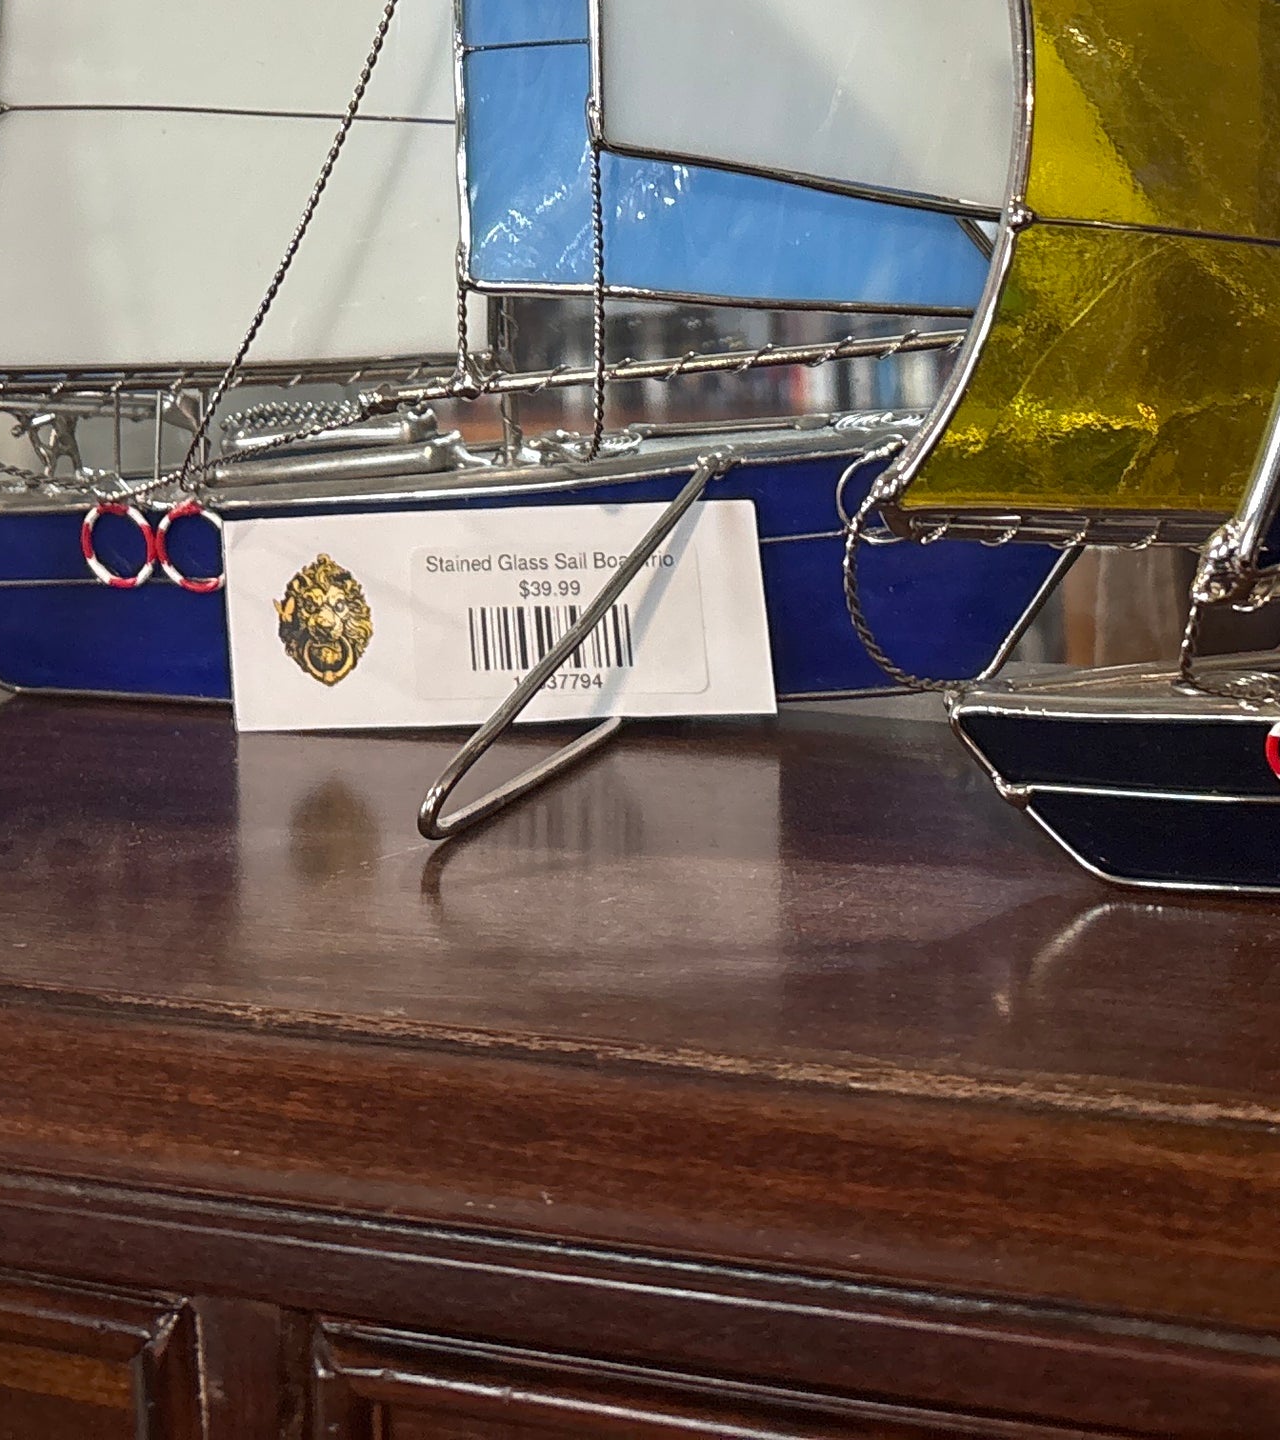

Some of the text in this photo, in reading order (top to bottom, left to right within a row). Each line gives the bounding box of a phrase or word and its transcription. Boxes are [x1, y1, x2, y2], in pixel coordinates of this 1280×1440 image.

[425, 554, 492, 573] Stained
[498, 553, 549, 571] Glass
[554, 552, 588, 570] Sail
[644, 550, 674, 568] rio
[518, 579, 581, 600] $39.99
[513, 673, 603, 690] 137794
